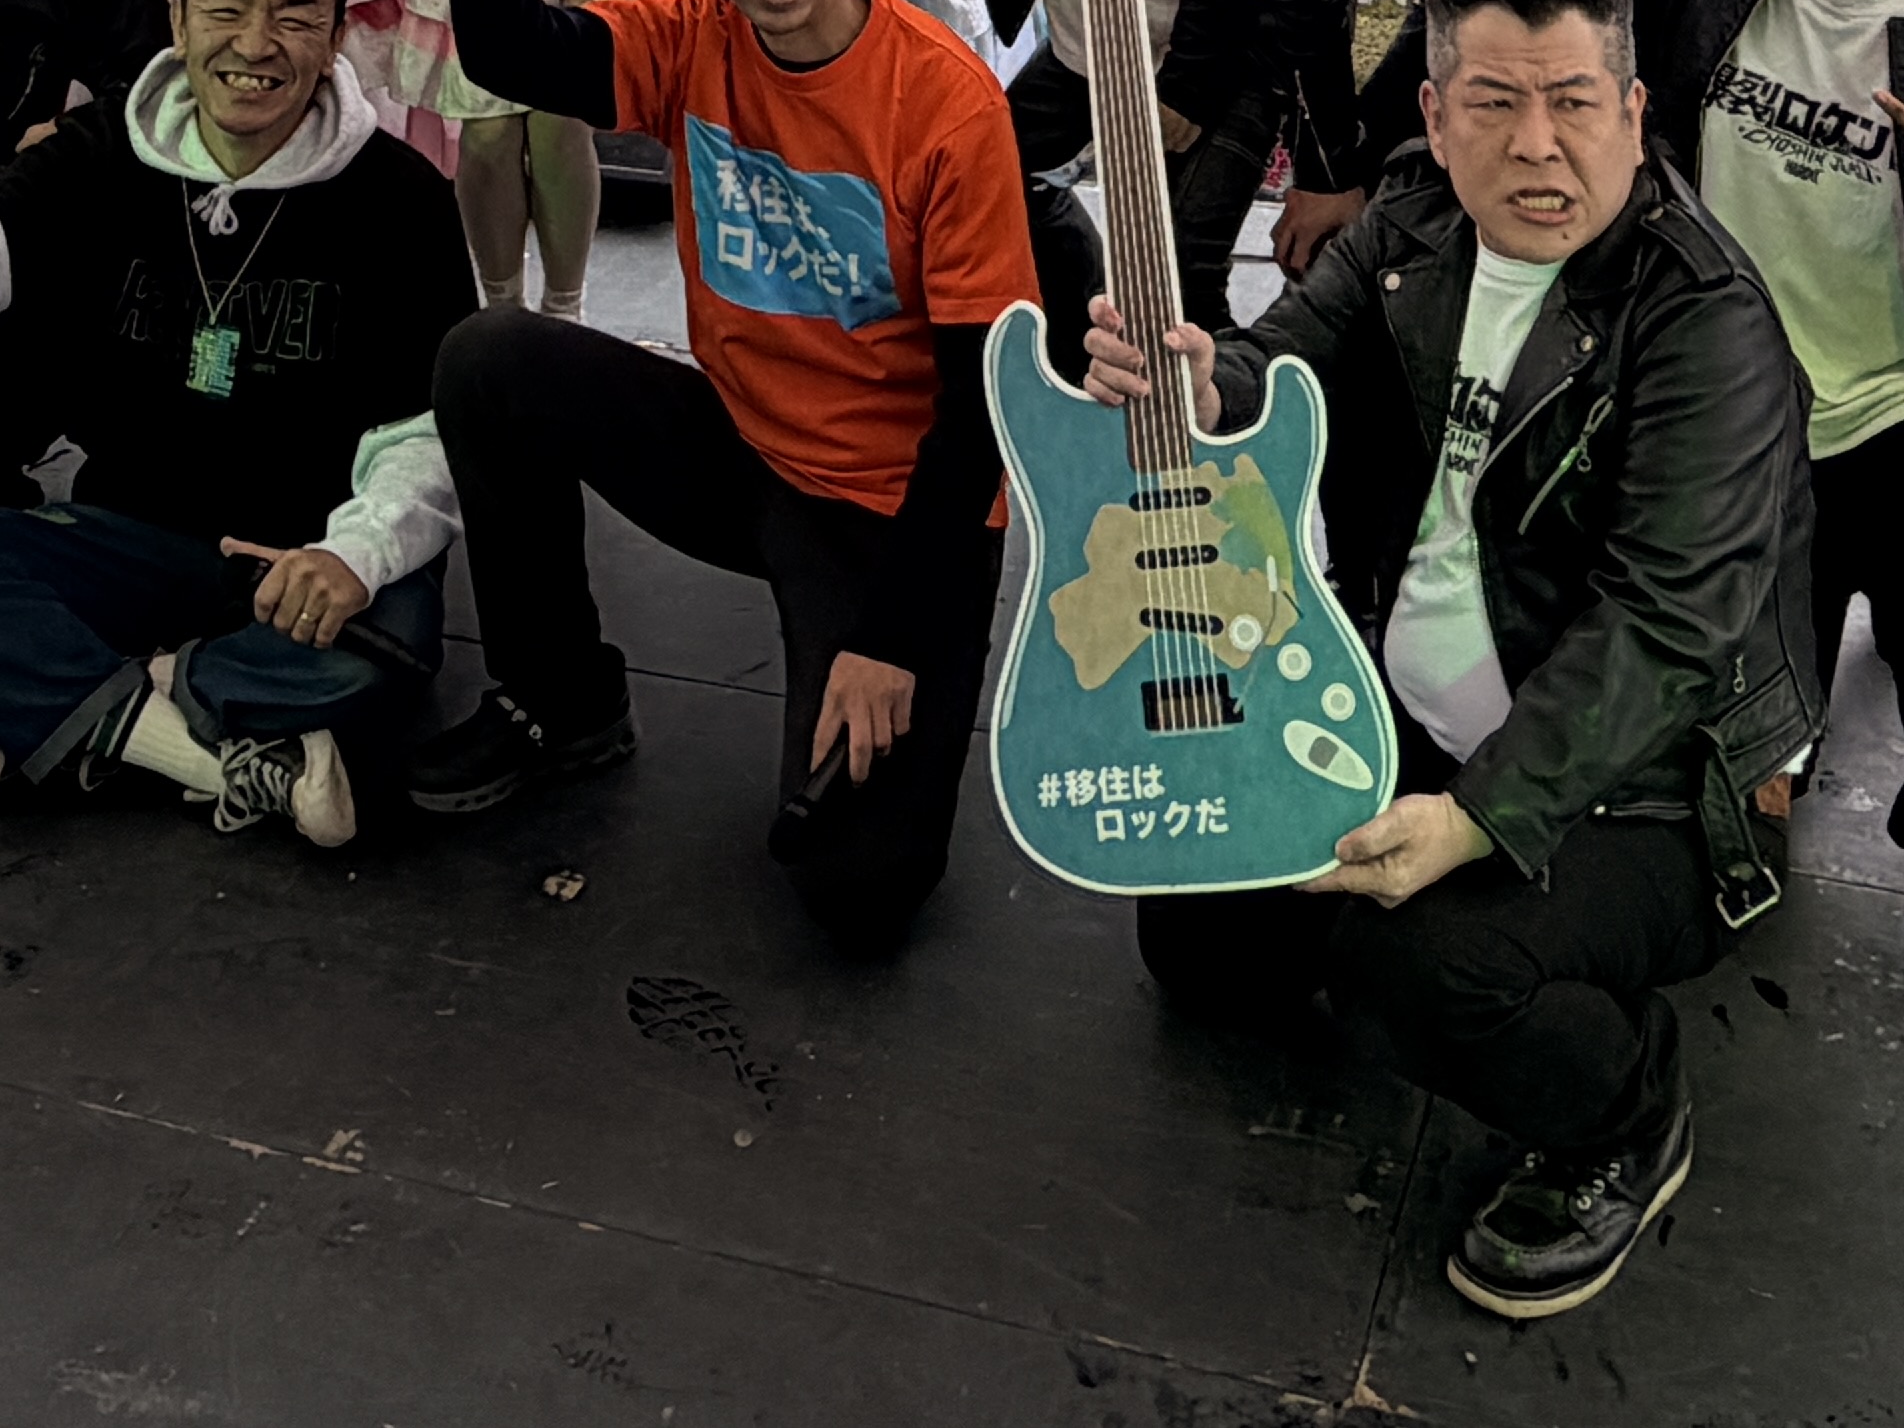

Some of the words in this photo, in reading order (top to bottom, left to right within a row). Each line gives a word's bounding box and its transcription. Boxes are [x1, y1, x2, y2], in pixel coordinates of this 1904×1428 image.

[717, 220, 863, 297] ロックだ!
[1036, 763, 1166, 809] #移住は
[1095, 796, 1230, 842] ロックだ
